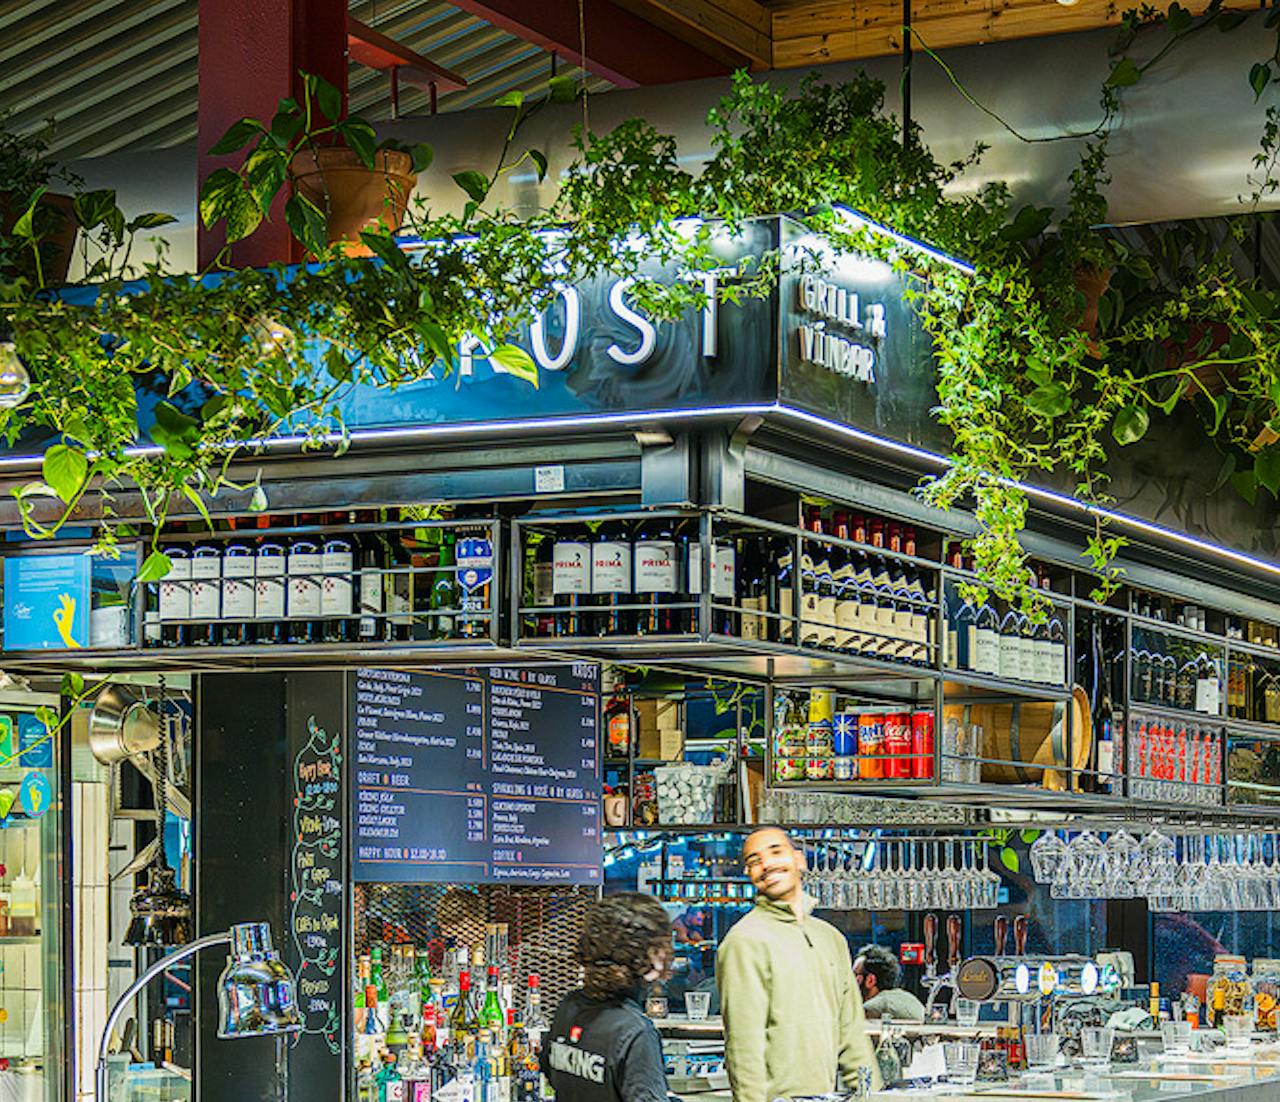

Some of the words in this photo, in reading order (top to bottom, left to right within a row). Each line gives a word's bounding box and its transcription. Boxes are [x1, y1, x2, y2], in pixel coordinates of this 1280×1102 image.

[799, 273, 863, 328] GRILL
[866, 303, 887, 337] &
[555, 559, 582, 569] PRIMA
[595, 559, 623, 568] PRIMA
[642, 558, 671, 568] PRIMA
